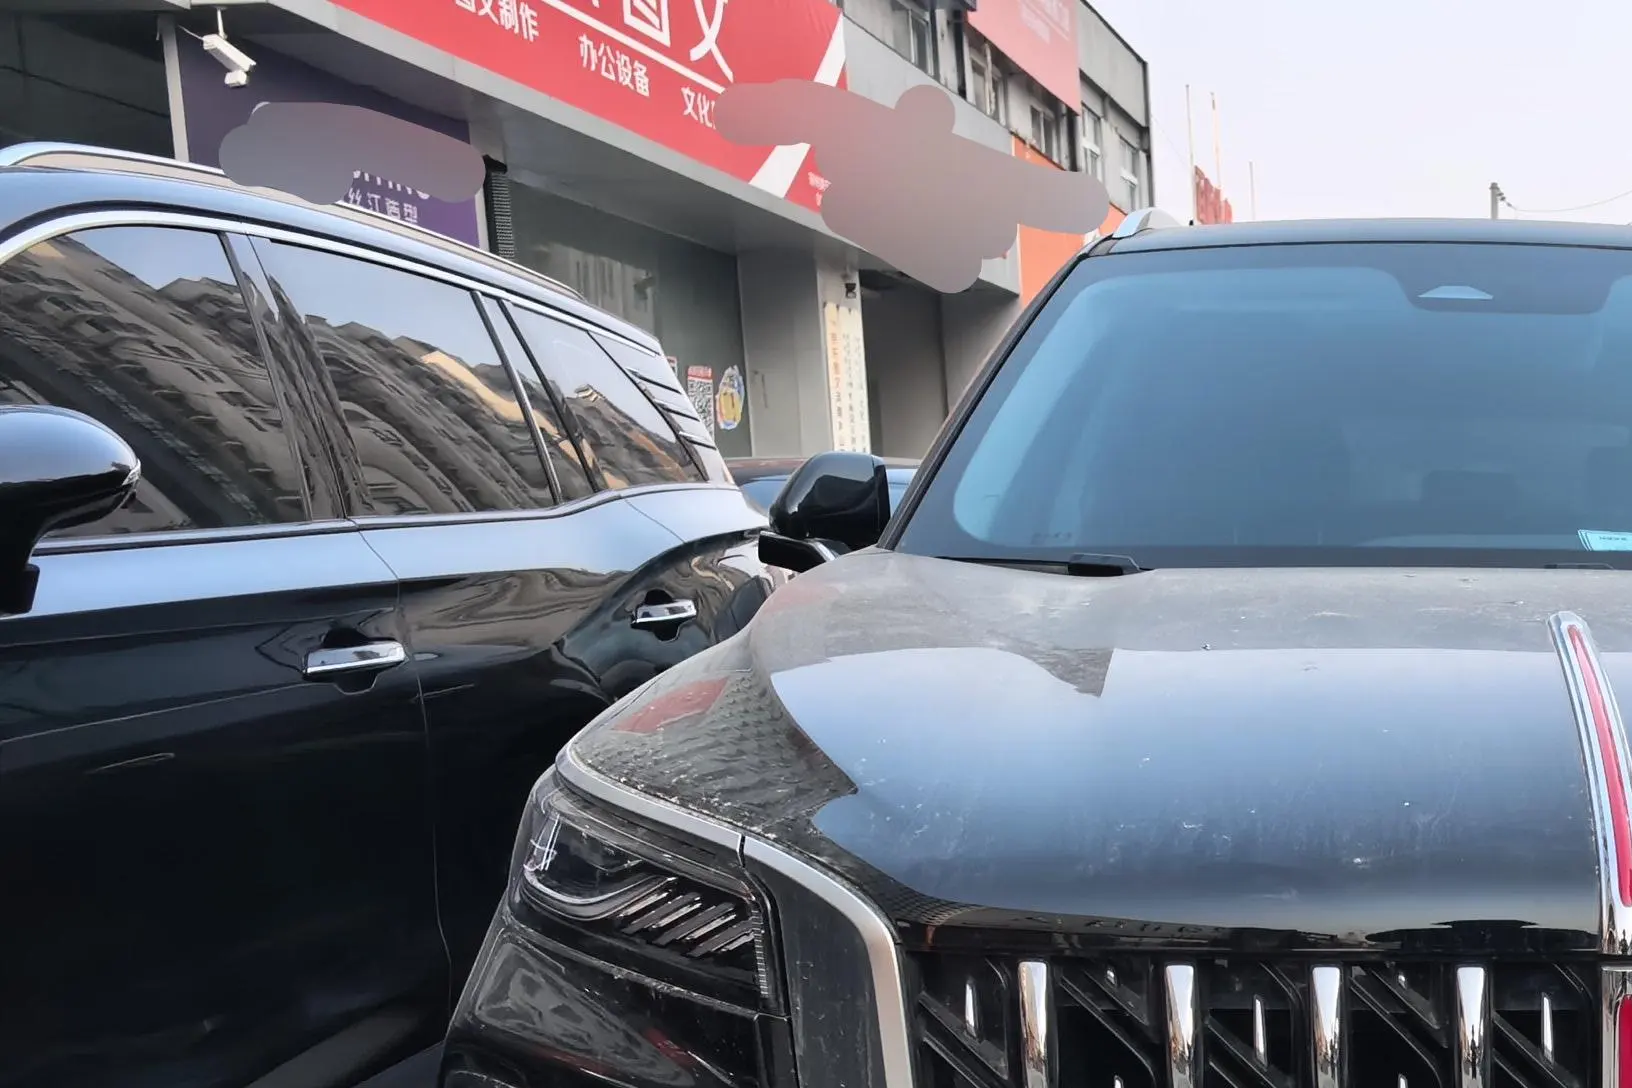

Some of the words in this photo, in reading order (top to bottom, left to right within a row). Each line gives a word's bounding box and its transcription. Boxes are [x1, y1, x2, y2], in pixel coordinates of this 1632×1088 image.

[578, 34, 650, 97] 办公设备
[681, 87, 716, 130] 文化
